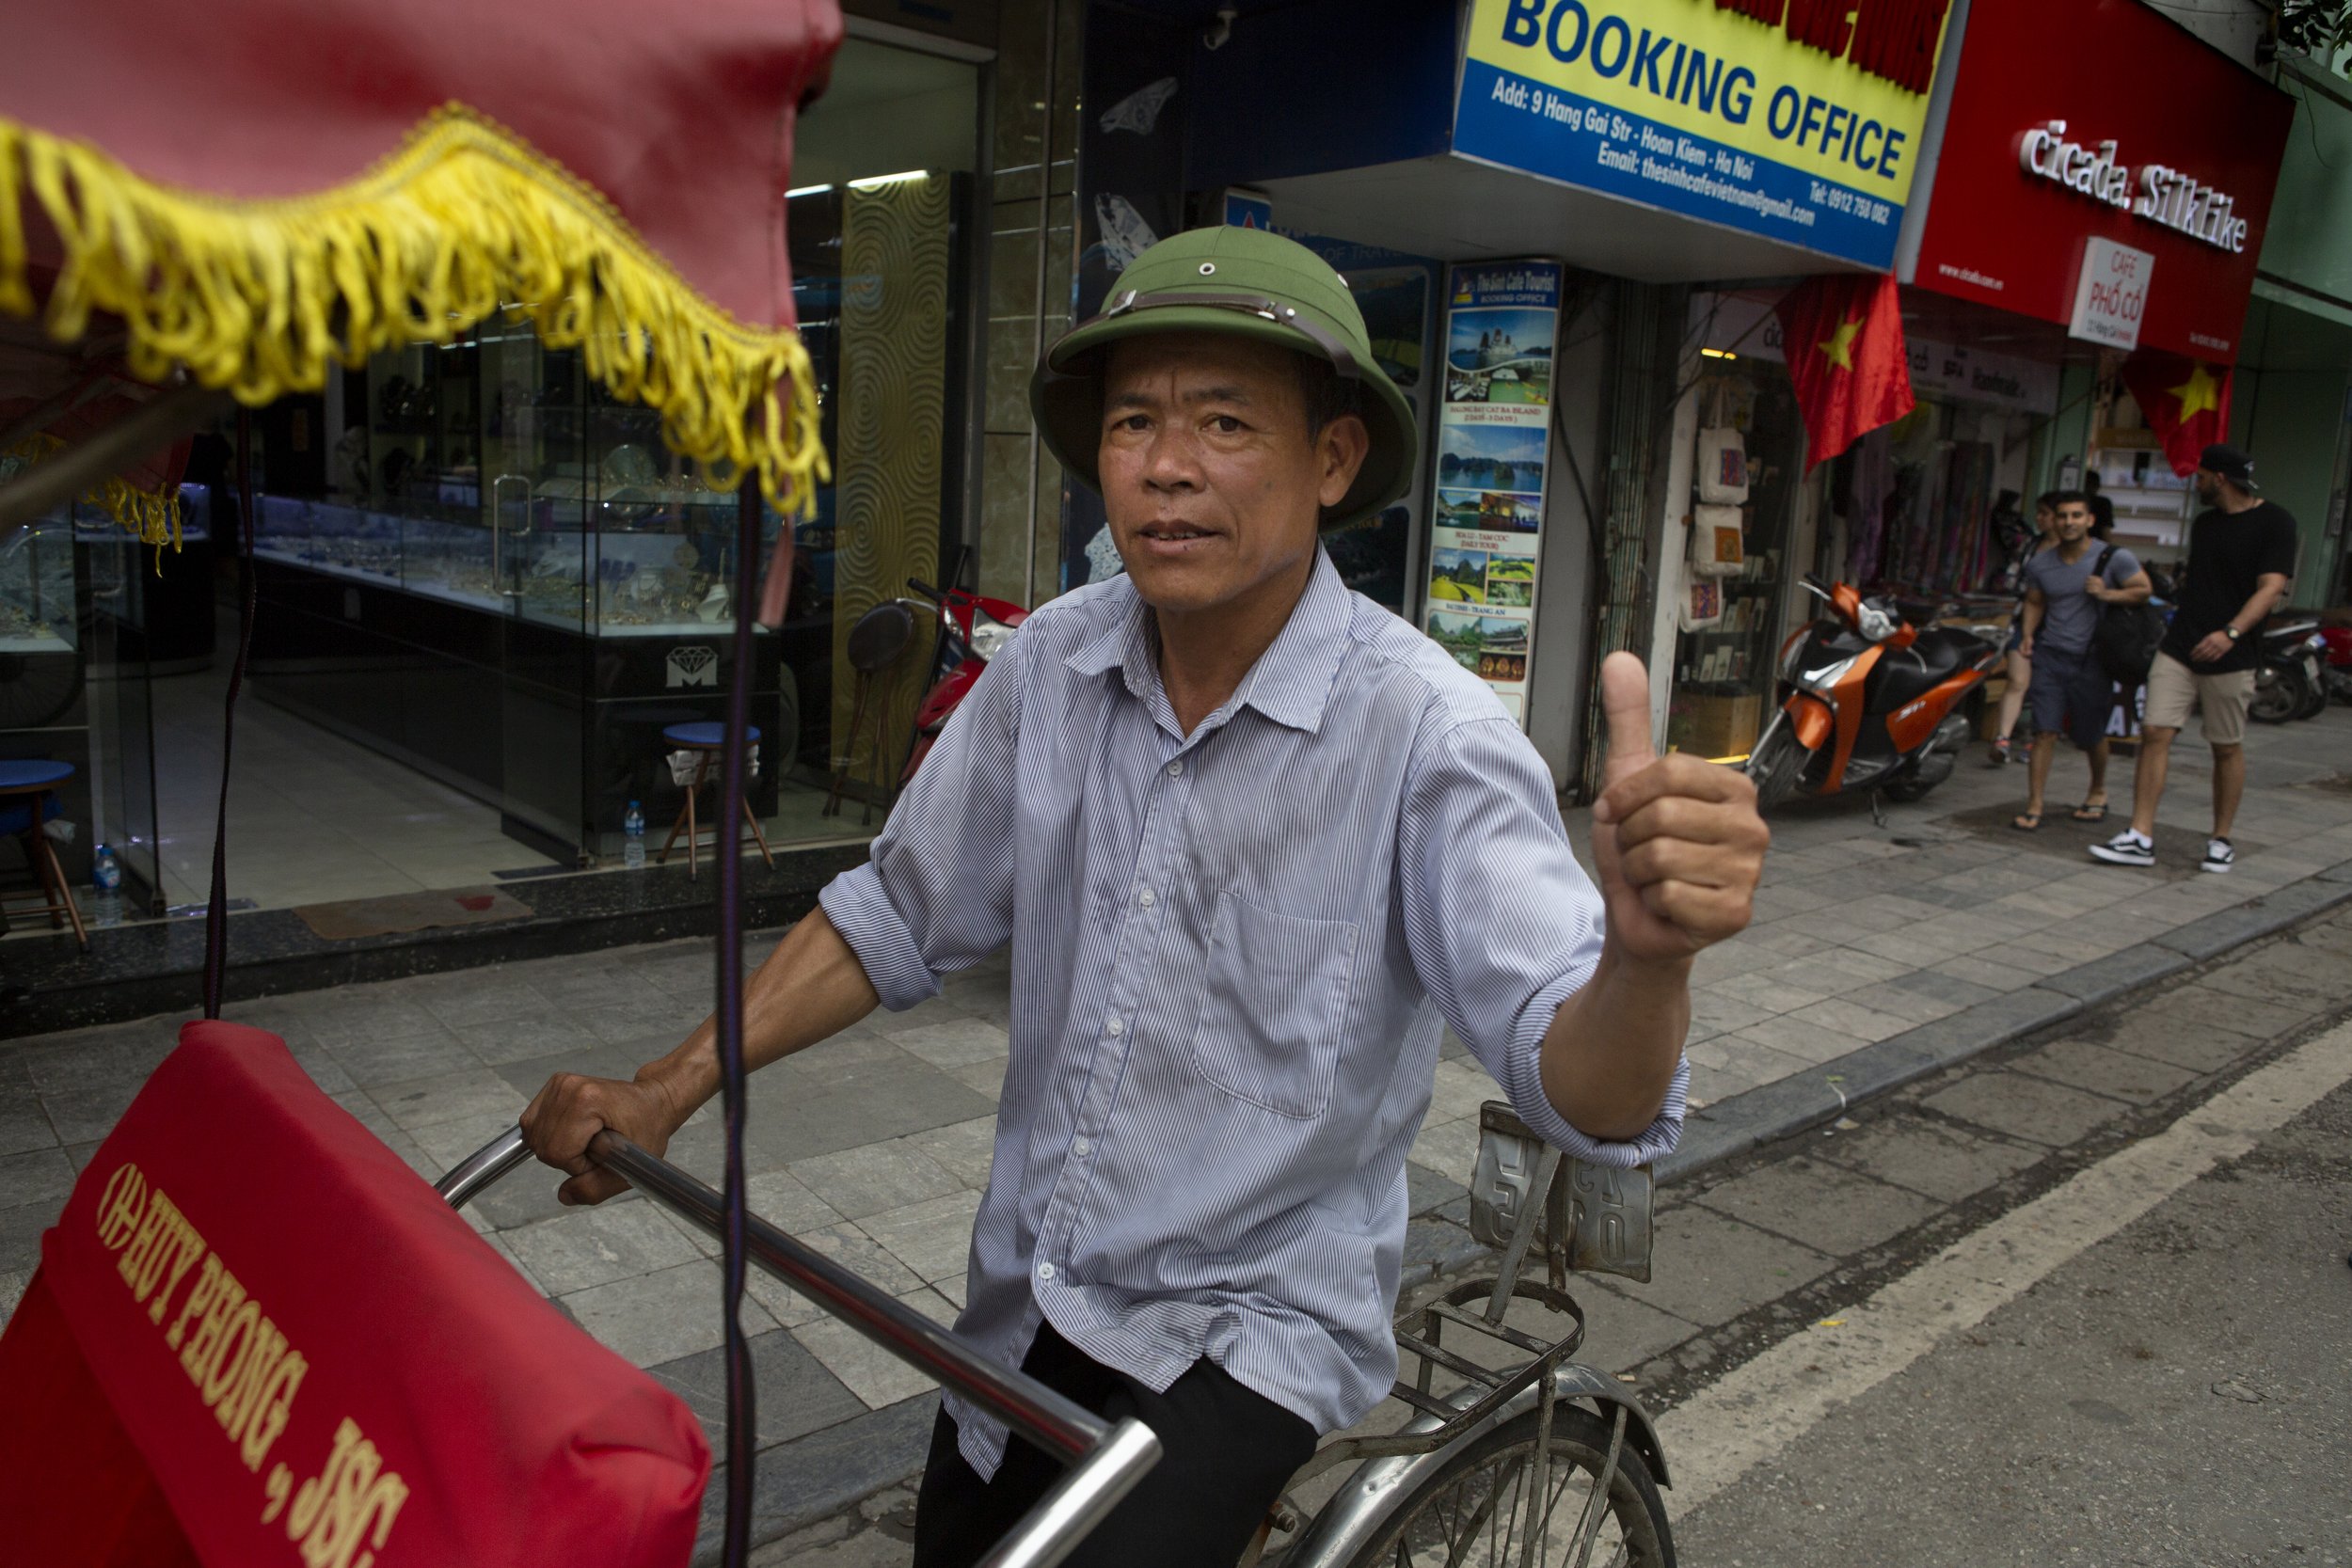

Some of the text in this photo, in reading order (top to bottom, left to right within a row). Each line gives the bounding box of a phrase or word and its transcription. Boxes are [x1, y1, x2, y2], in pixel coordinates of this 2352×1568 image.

[1491, 76, 1530, 110] Add:
[1531, 89, 1544, 114] 9
[1544, 93, 1582, 132] Hang
[1584, 106, 1610, 135] Gai
[1610, 115, 1633, 142] Str
[1640, 125, 1675, 156] Hoan
[1676, 136, 1708, 166] Kiem
[1714, 150, 1732, 175] Ha
[1732, 155, 1756, 182] Noi
[1502, 0, 1756, 125] BOOKING
[1767, 85, 1906, 180] OFFICE
[1597, 140, 1817, 228] Email: thesinhcafevietnam@gmail.com
[1809, 180, 1828, 205] Tel:
[2110, 250, 2137, 279] CAFE
[117, 1188, 208, 1326] HUY
